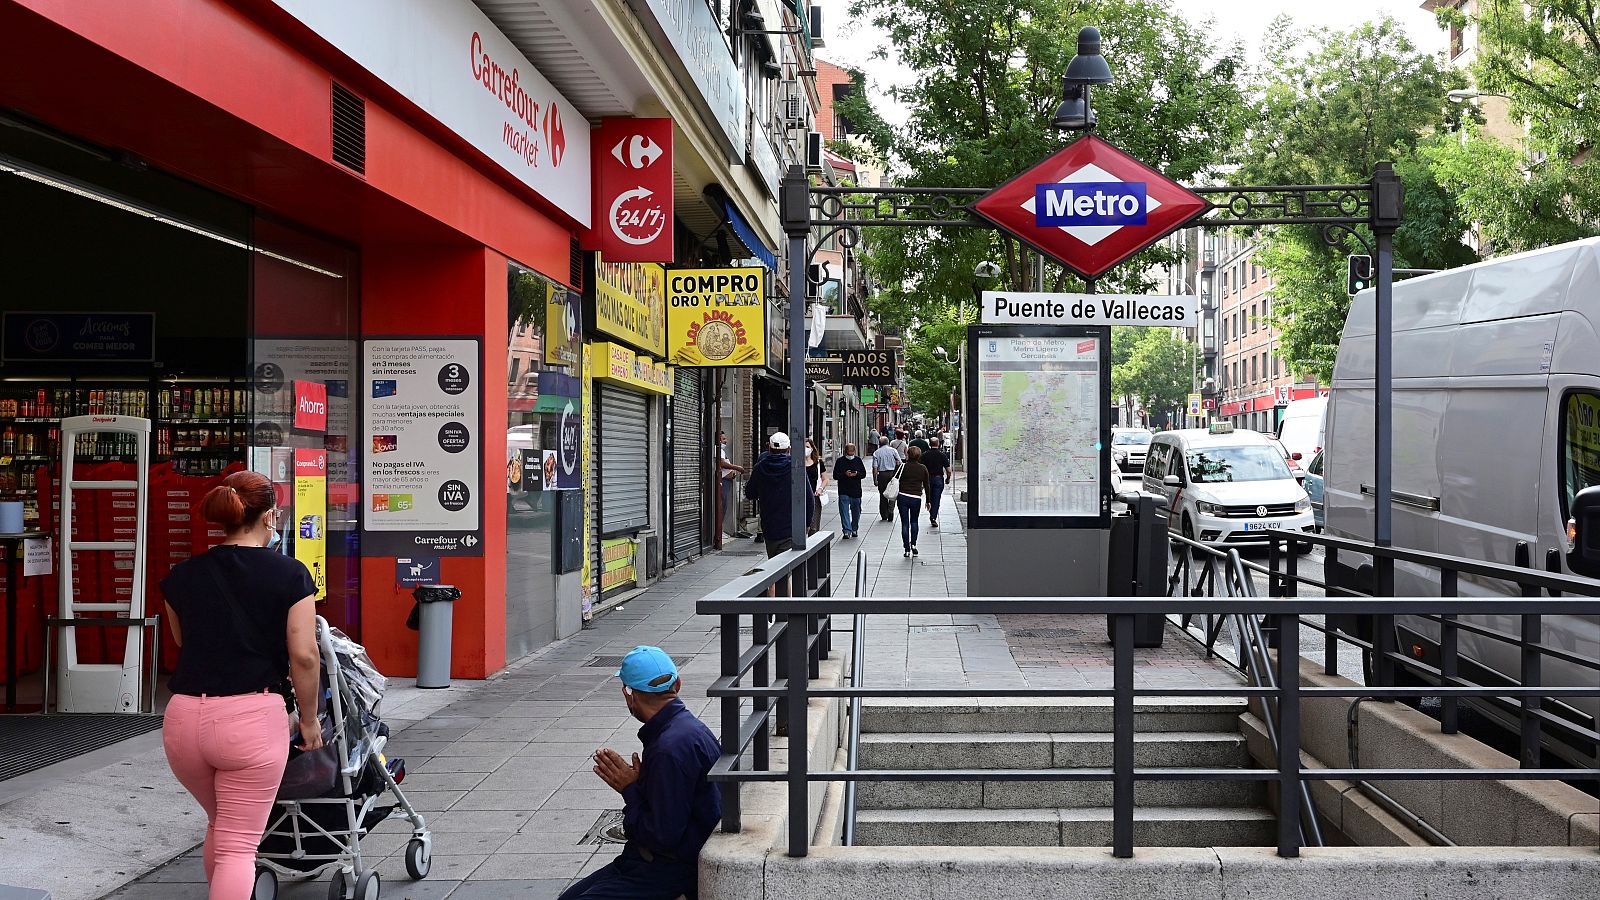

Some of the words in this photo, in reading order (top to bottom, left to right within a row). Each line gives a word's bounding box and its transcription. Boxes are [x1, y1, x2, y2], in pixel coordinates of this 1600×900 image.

[470, 31, 540, 132] Carrefour
[503, 121, 539, 168] market
[1045, 189, 1139, 217] Metro
[619, 209, 661, 227] 24/7
[671, 274, 759, 294] COMPRO
[671, 294, 699, 308] ORO
[702, 294, 712, 307] Y
[714, 292, 760, 307] PLATA
[995, 297, 1065, 318] Puente
[1071, 299, 1096, 319] de
[1102, 299, 1185, 321] Vallecas
[80, 317, 131, 336] Acciones
[686, 321, 701, 346] LOS
[703, 309, 747, 345] ADOLFOS
[1043, 339, 1067, 347] Metro,
[448, 365, 459, 378] 3
[299, 396, 324, 415] Ahorra
[414, 536, 458, 544] Carrefour
